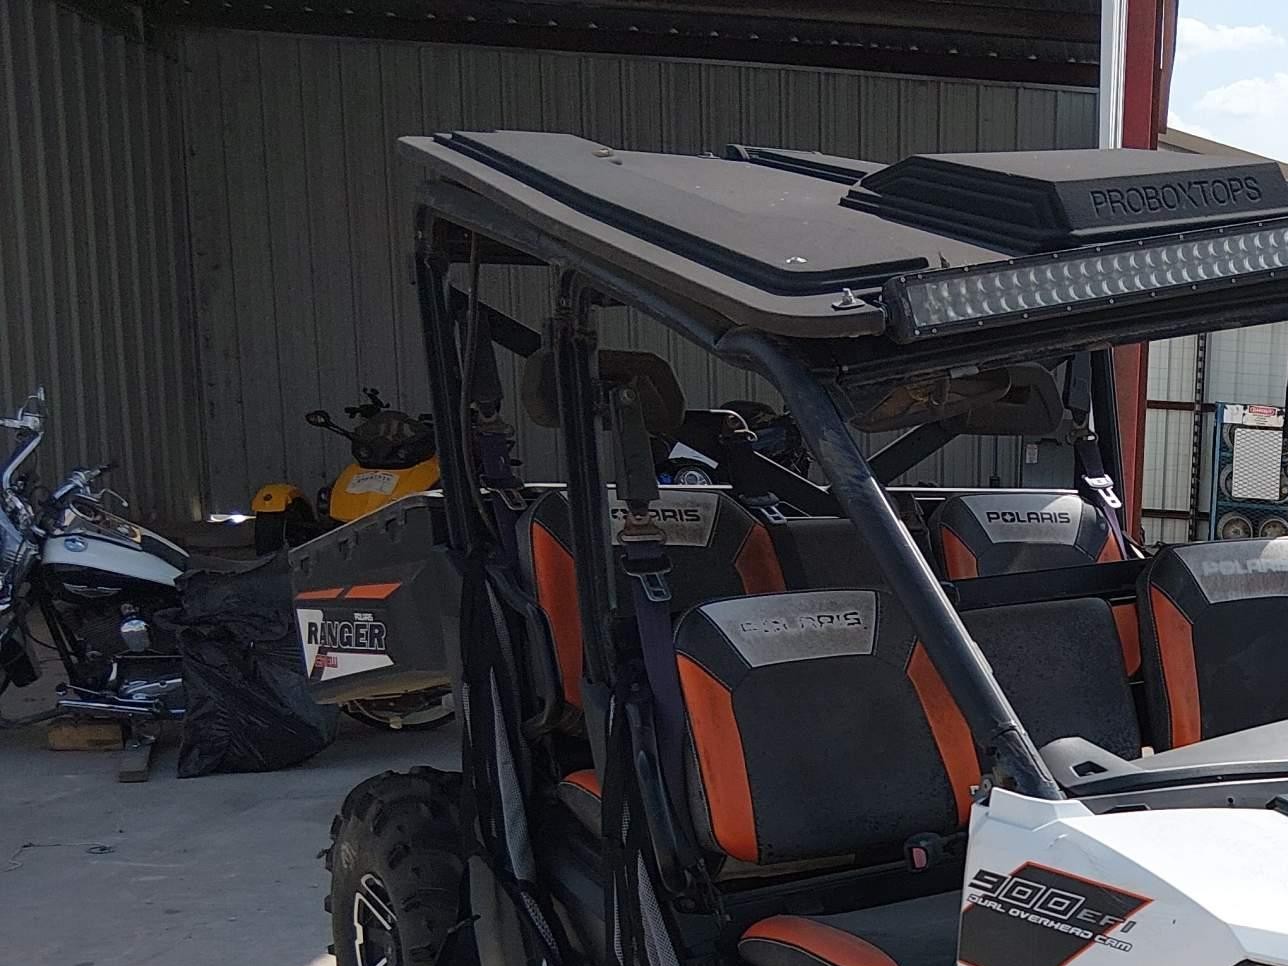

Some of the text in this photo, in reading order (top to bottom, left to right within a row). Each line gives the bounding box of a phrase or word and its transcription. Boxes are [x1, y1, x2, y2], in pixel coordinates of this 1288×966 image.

[1090, 176, 1262, 217] PROBOXTOPS
[986, 511, 1071, 524] POLARIS
[307, 621, 386, 650] RANGER
[968, 868, 1137, 933] 900 EFI
[968, 893, 1133, 953] DUAL OVERHEAD CAM
